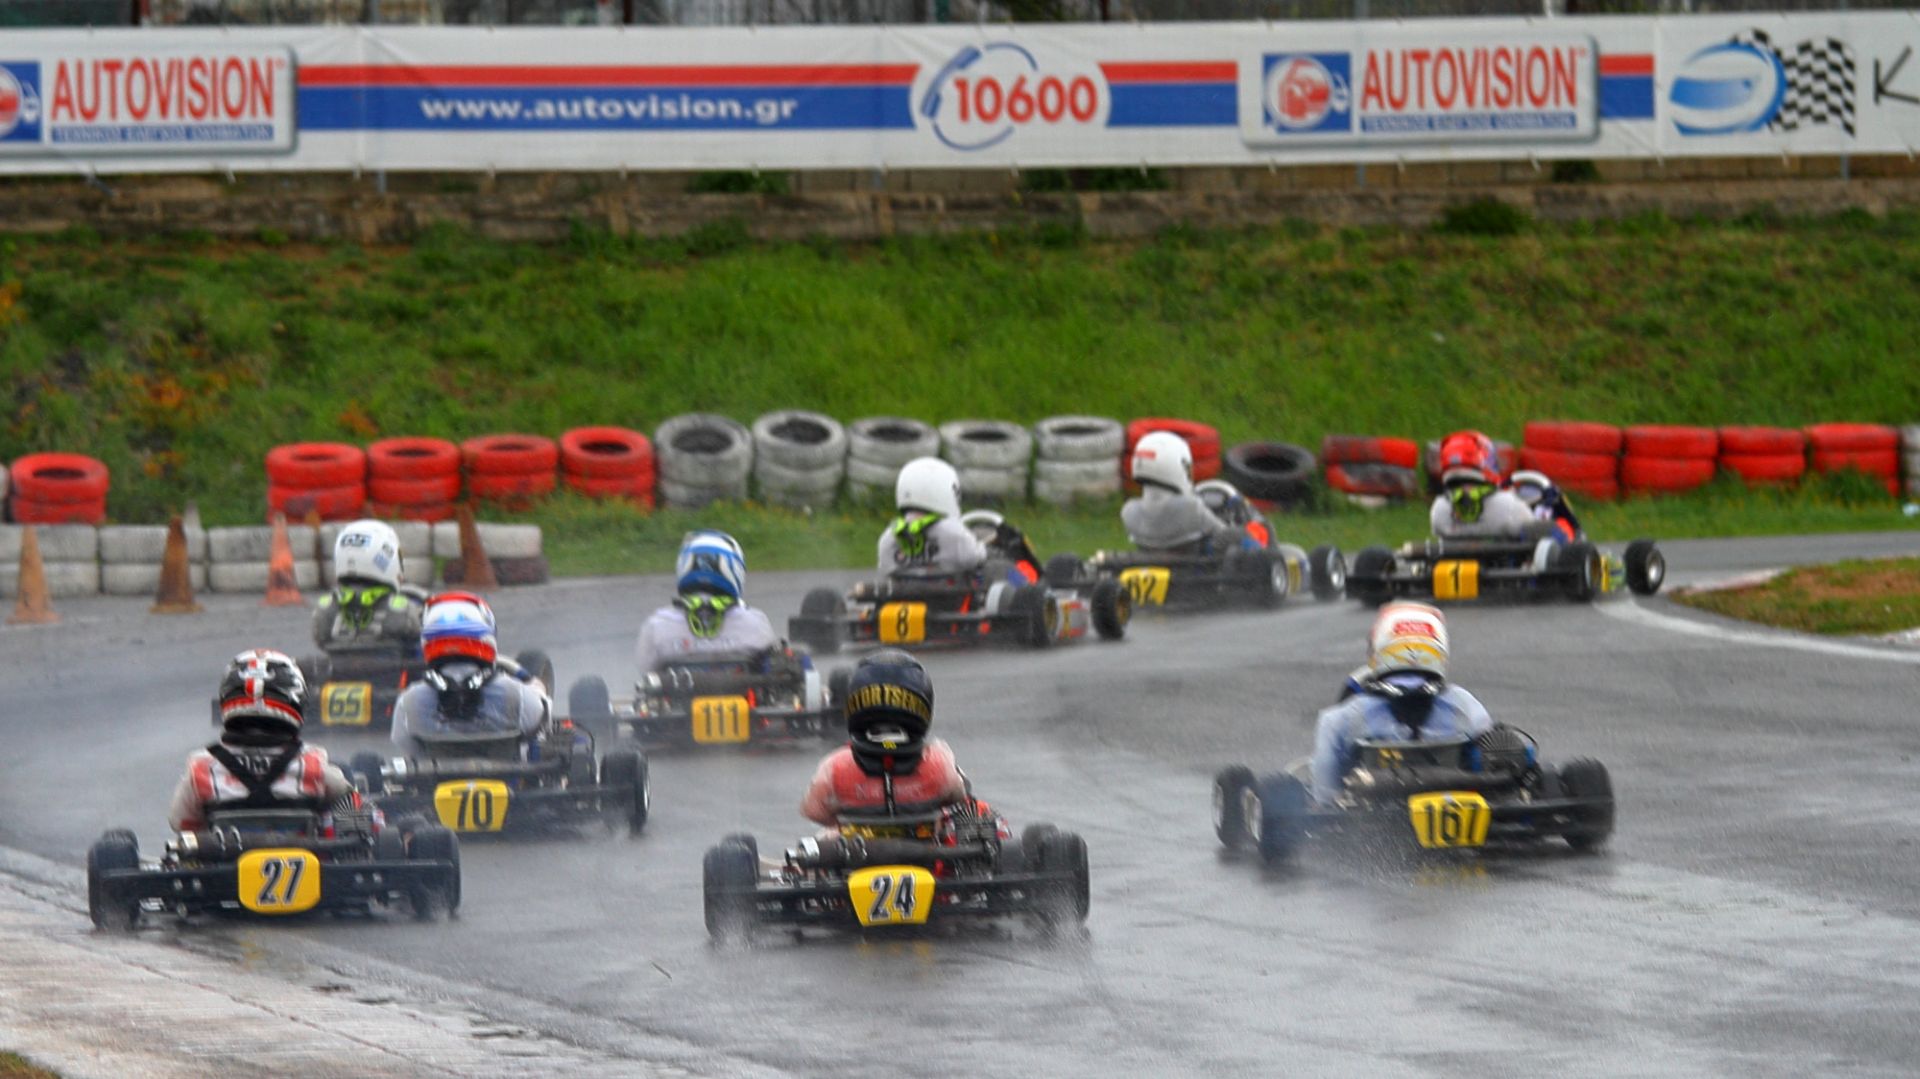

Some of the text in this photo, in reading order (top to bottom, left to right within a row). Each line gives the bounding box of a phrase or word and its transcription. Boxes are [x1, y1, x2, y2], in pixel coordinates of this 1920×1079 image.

[51, 56, 275, 121] AUTOVISION
[954, 74, 1098, 123] 10600
[1360, 46, 1578, 110] AUTOVISION
[419, 94, 798, 123] www.autovision.gr
[1449, 562, 1460, 595] 1
[896, 605, 909, 638] 8
[328, 687, 361, 719] 65
[703, 702, 740, 738] 111
[451, 788, 494, 830] 70
[1423, 801, 1481, 847] 167
[257, 856, 305, 906] 27
[868, 872, 915, 921] 24
